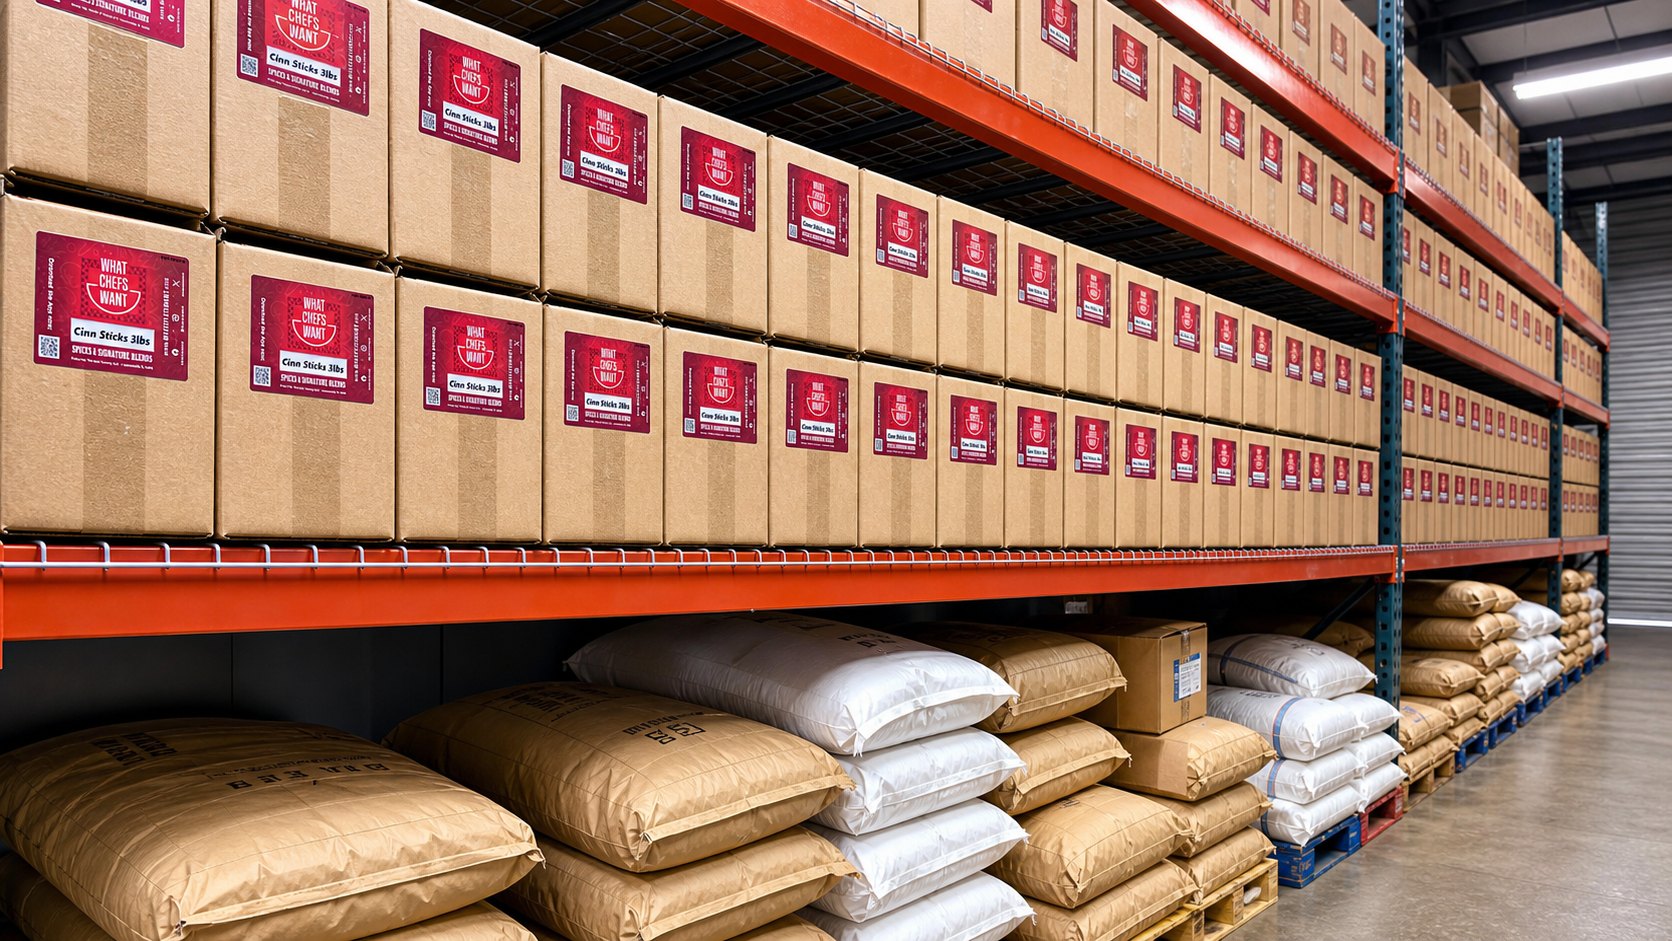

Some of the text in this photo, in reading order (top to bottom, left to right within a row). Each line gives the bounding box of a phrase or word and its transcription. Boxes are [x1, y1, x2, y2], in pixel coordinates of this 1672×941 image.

[288, 9, 319, 30] CHEFS
[290, 24, 318, 45] WANT
[270, 53, 337, 80] Cinn Sticks 3lbs
[100, 258, 127, 275] WHAT
[100, 274, 128, 291] CHEFS
[100, 290, 127, 307] WANT
[304, 297, 325, 312] WHAT
[302, 311, 326, 326] CHEFS
[74, 327, 150, 346] Cinn Sticks 3lbs
[303, 325, 325, 340] WANT
[282, 358, 344, 373] Cinn Sticks 3lbs
